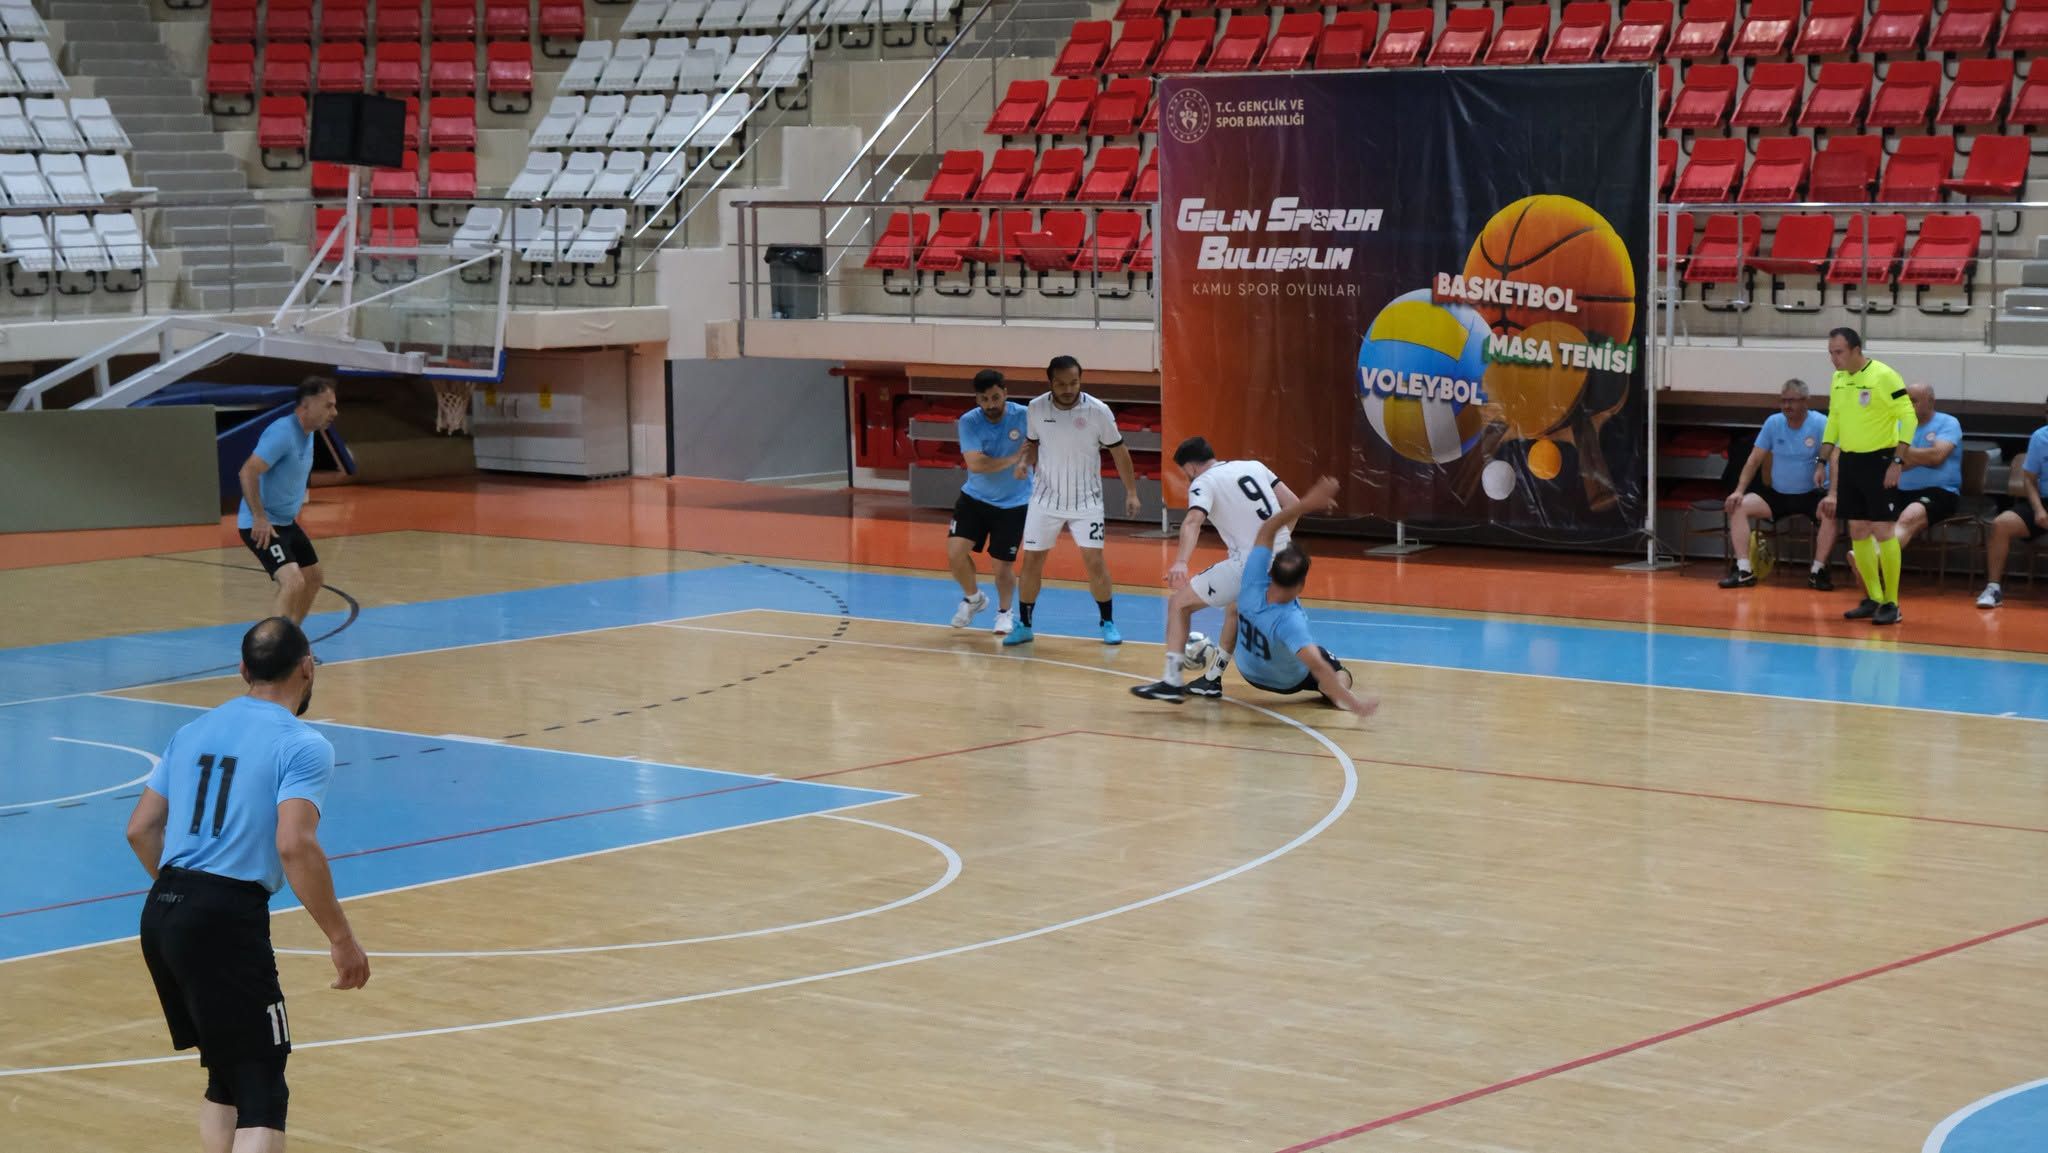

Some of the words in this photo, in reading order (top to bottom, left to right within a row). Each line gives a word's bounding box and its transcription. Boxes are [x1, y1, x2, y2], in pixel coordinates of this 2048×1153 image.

[1215, 101, 1236, 113] T.C.
[1238, 97, 1286, 114] GENÇLİK
[1290, 99, 1304, 111] VE
[1216, 116, 1244, 128] SPOR
[1246, 112, 1305, 127] BAKANLIĞI
[1192, 283, 1231, 296] KAMU
[1238, 283, 1279, 296] SPOR
[1286, 283, 1361, 297] OYUNLARI
[1435, 271, 1578, 313] BASKETBOL
[1487, 334, 1553, 365] MASA
[1558, 341, 1633, 374] TENİSİ
[1361, 366, 1483, 406] VOLEYBOL
[1237, 475, 1273, 521] 9
[270, 543, 286, 564] 9
[188, 753, 238, 839] 11
[266, 1001, 290, 1046] 11
